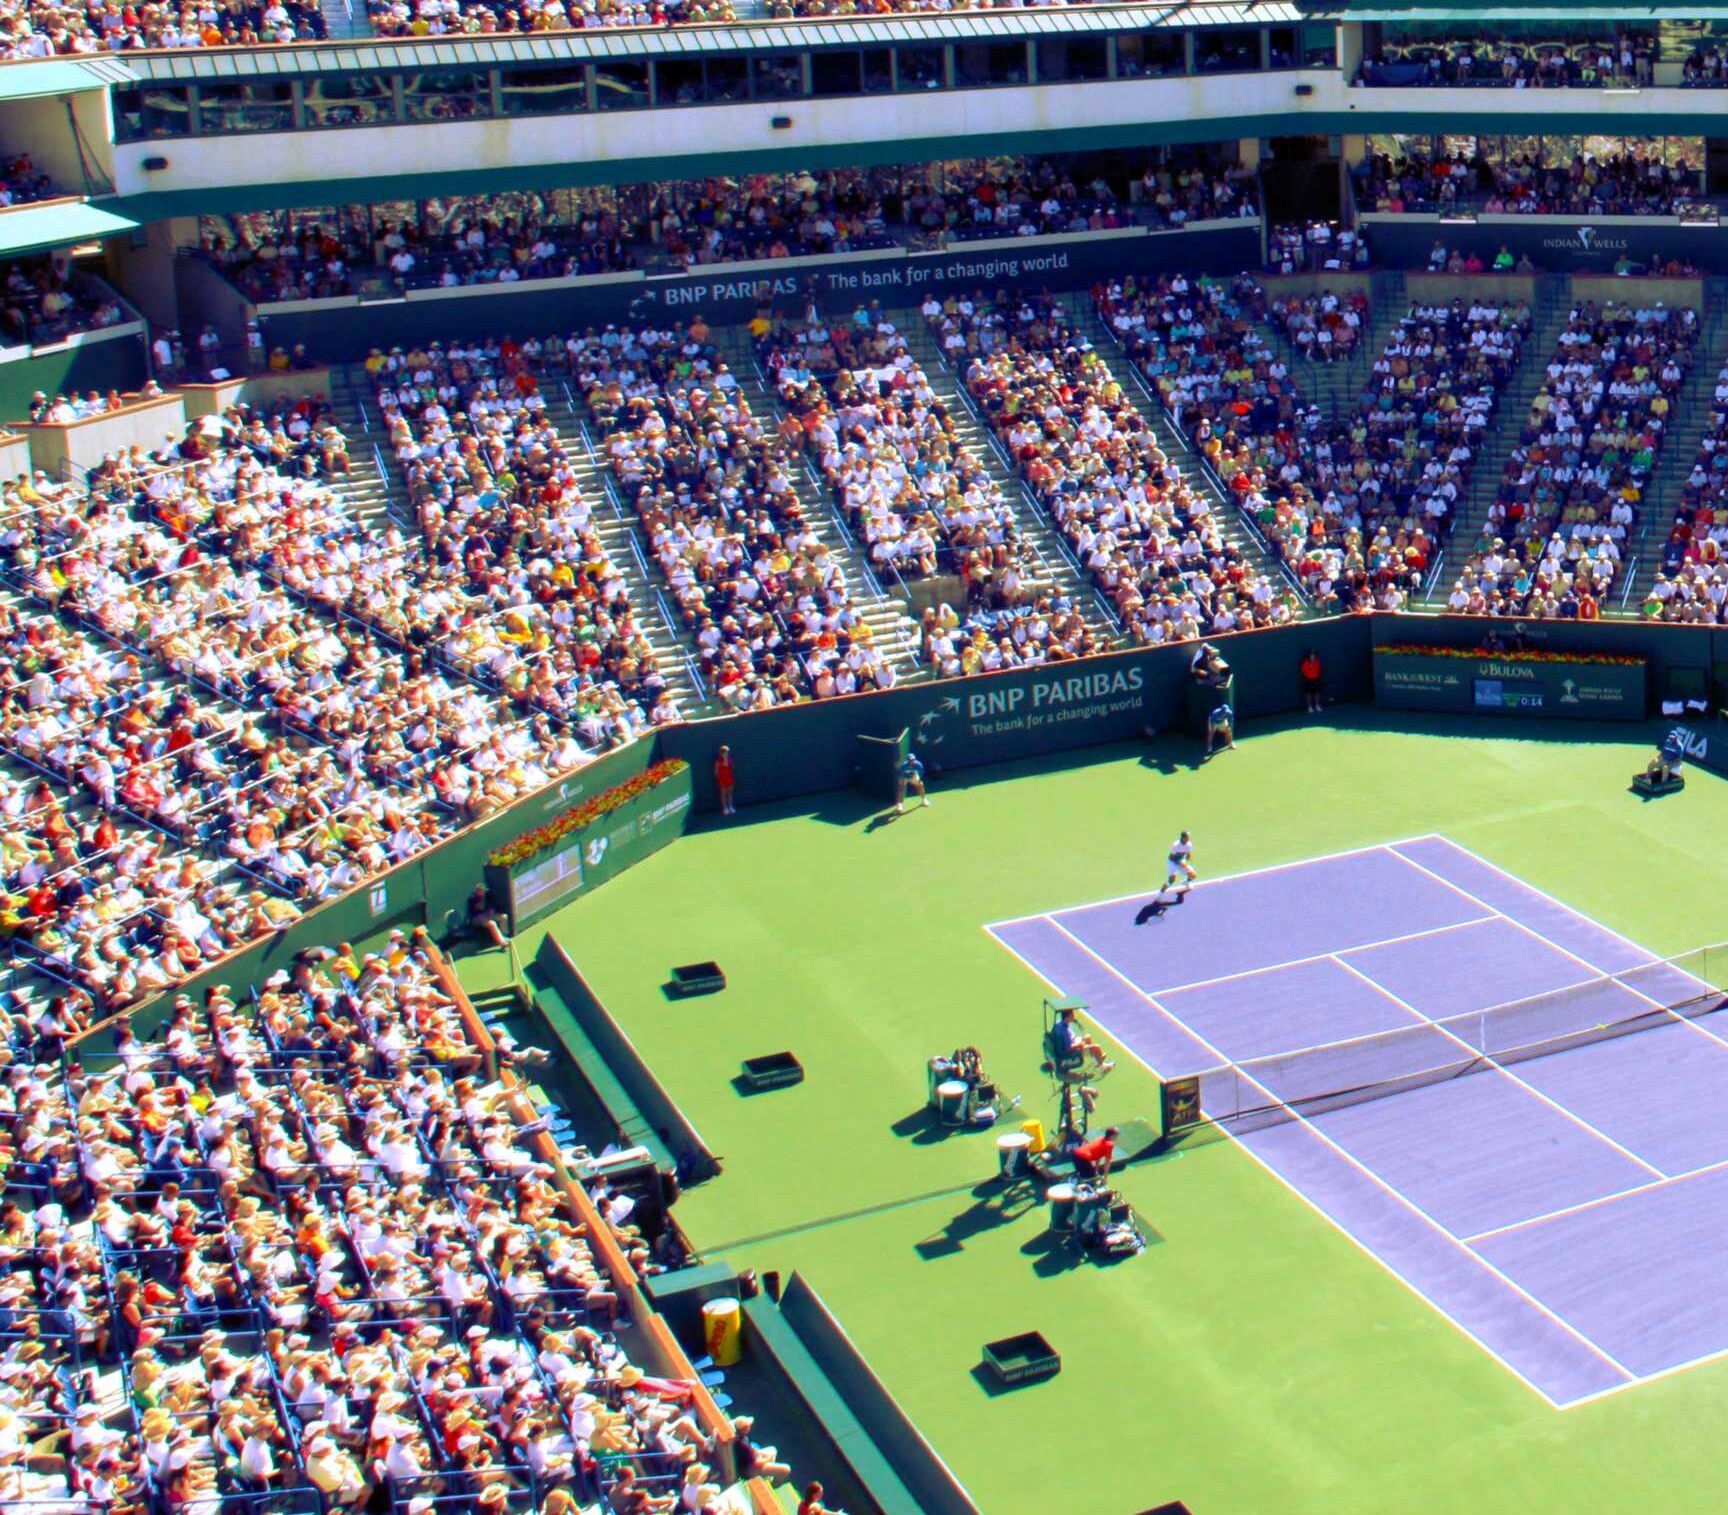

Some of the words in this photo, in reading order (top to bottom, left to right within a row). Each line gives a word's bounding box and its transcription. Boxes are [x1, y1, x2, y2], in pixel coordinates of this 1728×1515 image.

[1543, 238, 1580, 248] INDIAN
[1594, 239, 1627, 249] WELLS
[828, 273, 858, 289] The
[862, 268, 902, 286] bank
[906, 266, 930, 285] for
[935, 267, 945, 279] a
[948, 260, 1018, 279] changing
[1022, 252, 1068, 271] world
[666, 286, 707, 305] BNP
[712, 277, 797, 301] PARIAS
[1489, 663, 1535, 679] BULOVA
[969, 687, 1025, 719] BNP
[1032, 666, 1144, 708] PARIBAS
[972, 723, 993, 736] The
[995, 716, 1025, 732] bank
[1027, 714, 1044, 730] for
[1047, 714, 1054, 723] a
[1056, 704, 1108, 721] changing
[1109, 695, 1143, 712] world
